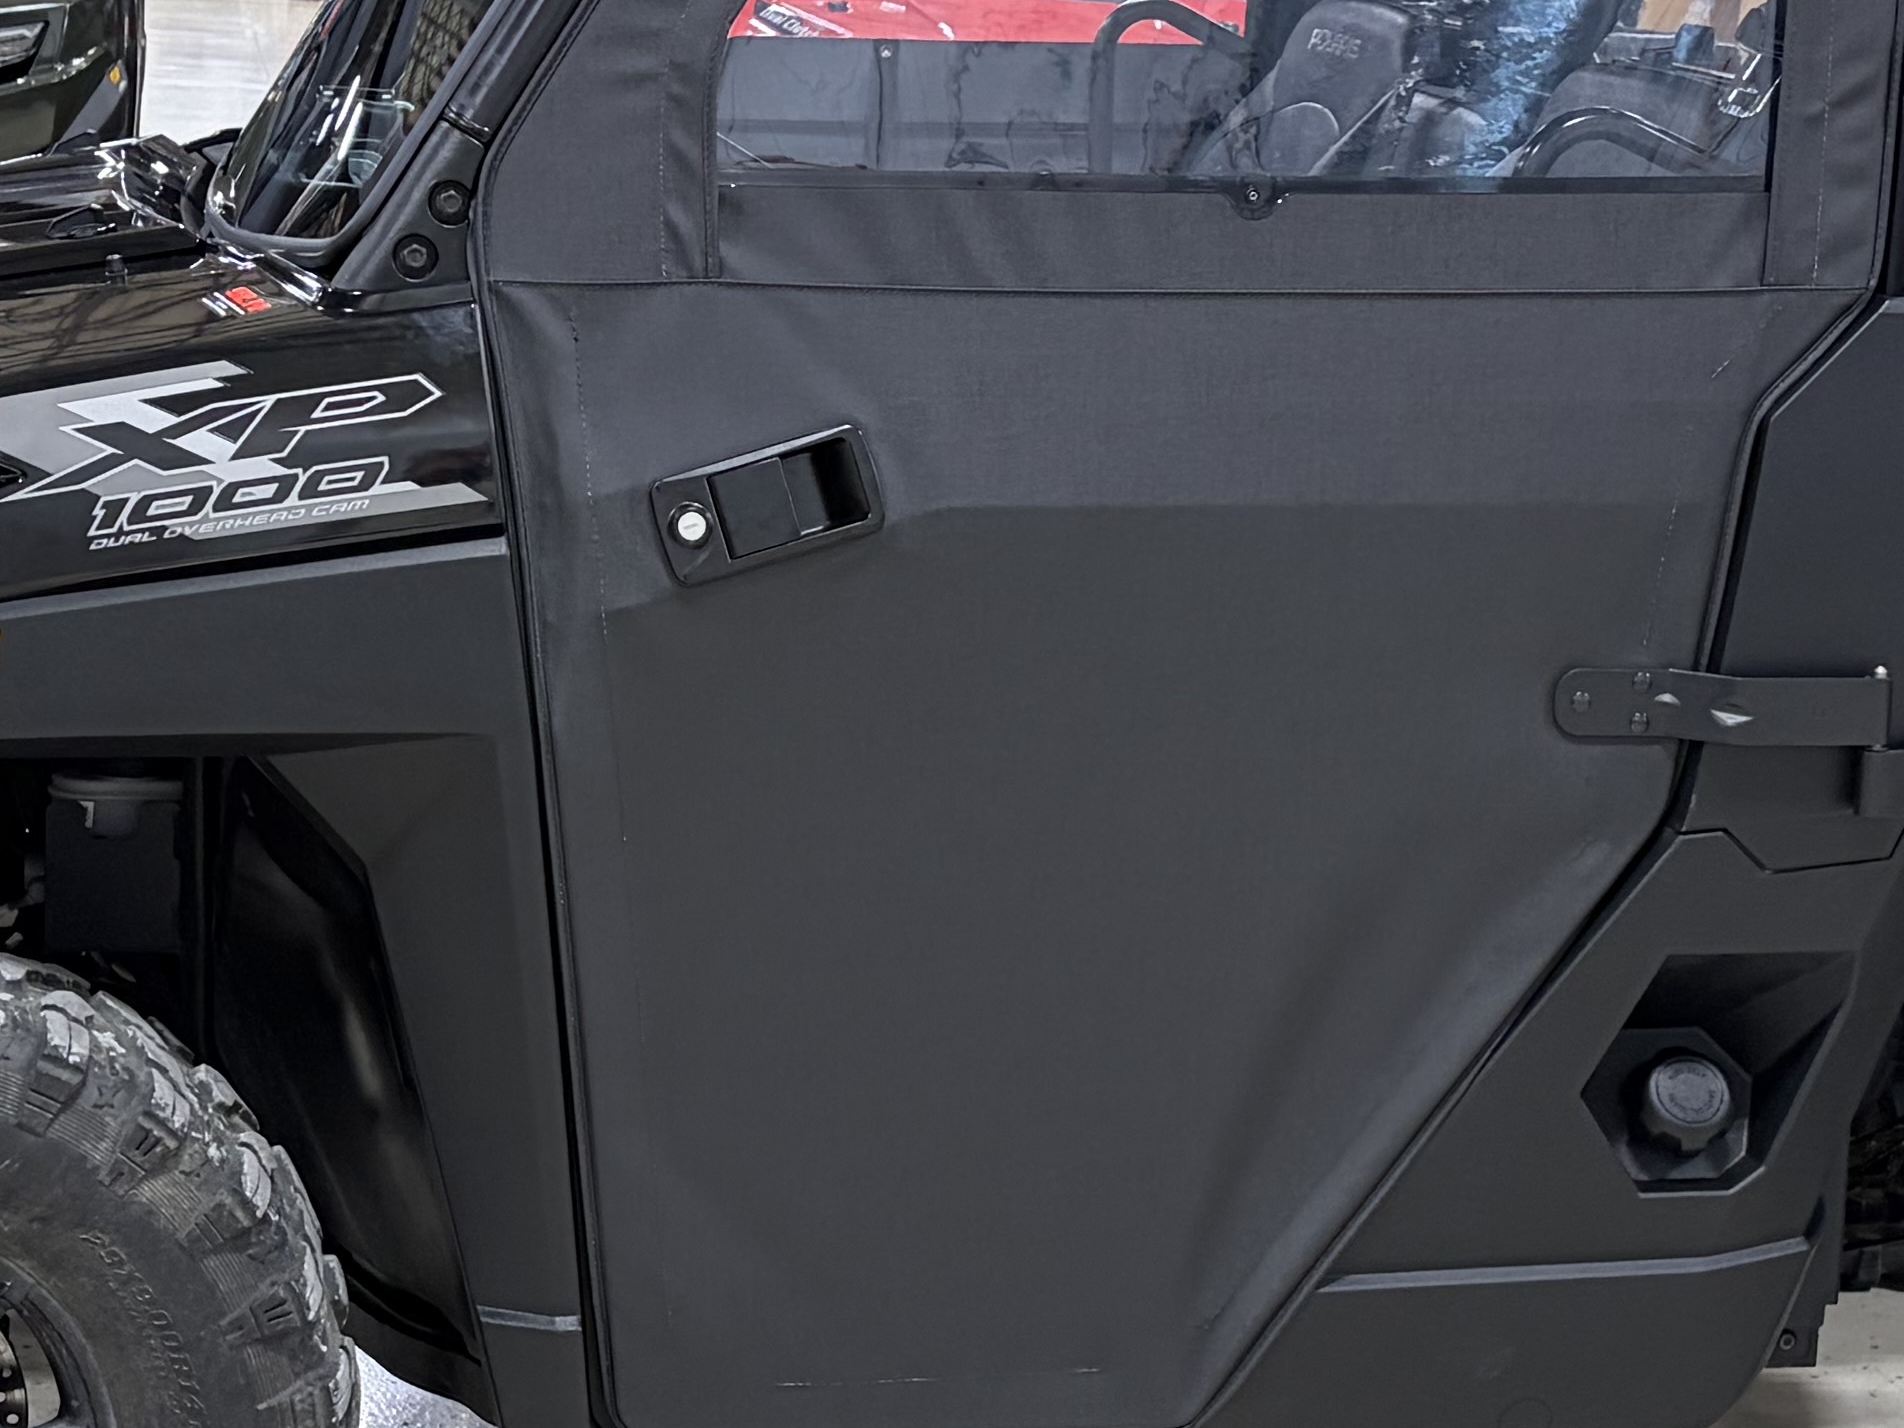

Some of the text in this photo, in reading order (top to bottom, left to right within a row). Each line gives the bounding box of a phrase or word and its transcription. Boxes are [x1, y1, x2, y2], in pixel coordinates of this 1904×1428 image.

[86, 455, 390, 539] 1000
[89, 498, 370, 551] DUAL OVERHEAD CAM
